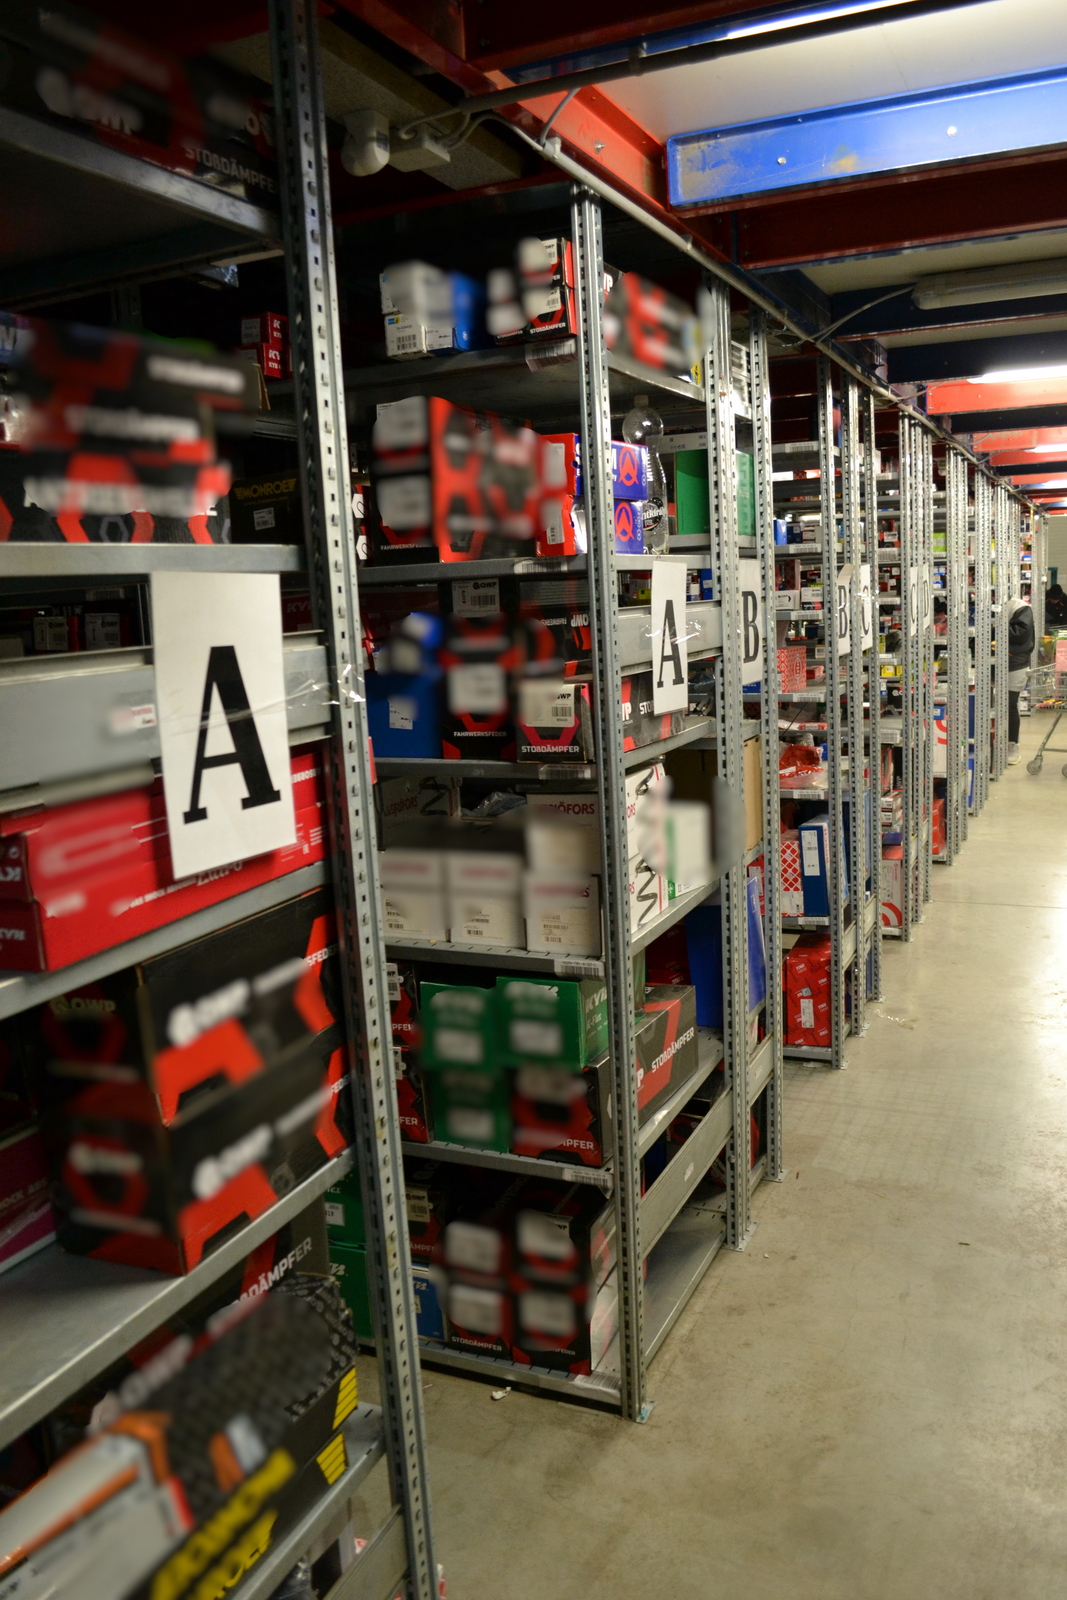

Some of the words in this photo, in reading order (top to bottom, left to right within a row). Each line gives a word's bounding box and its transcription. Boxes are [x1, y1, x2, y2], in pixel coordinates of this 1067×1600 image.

[241, 481, 289, 499] MONROE
[657, 599, 684, 688] A
[741, 590, 760, 663] B
[838, 585, 847, 638] B
[183, 645, 281, 824] A
